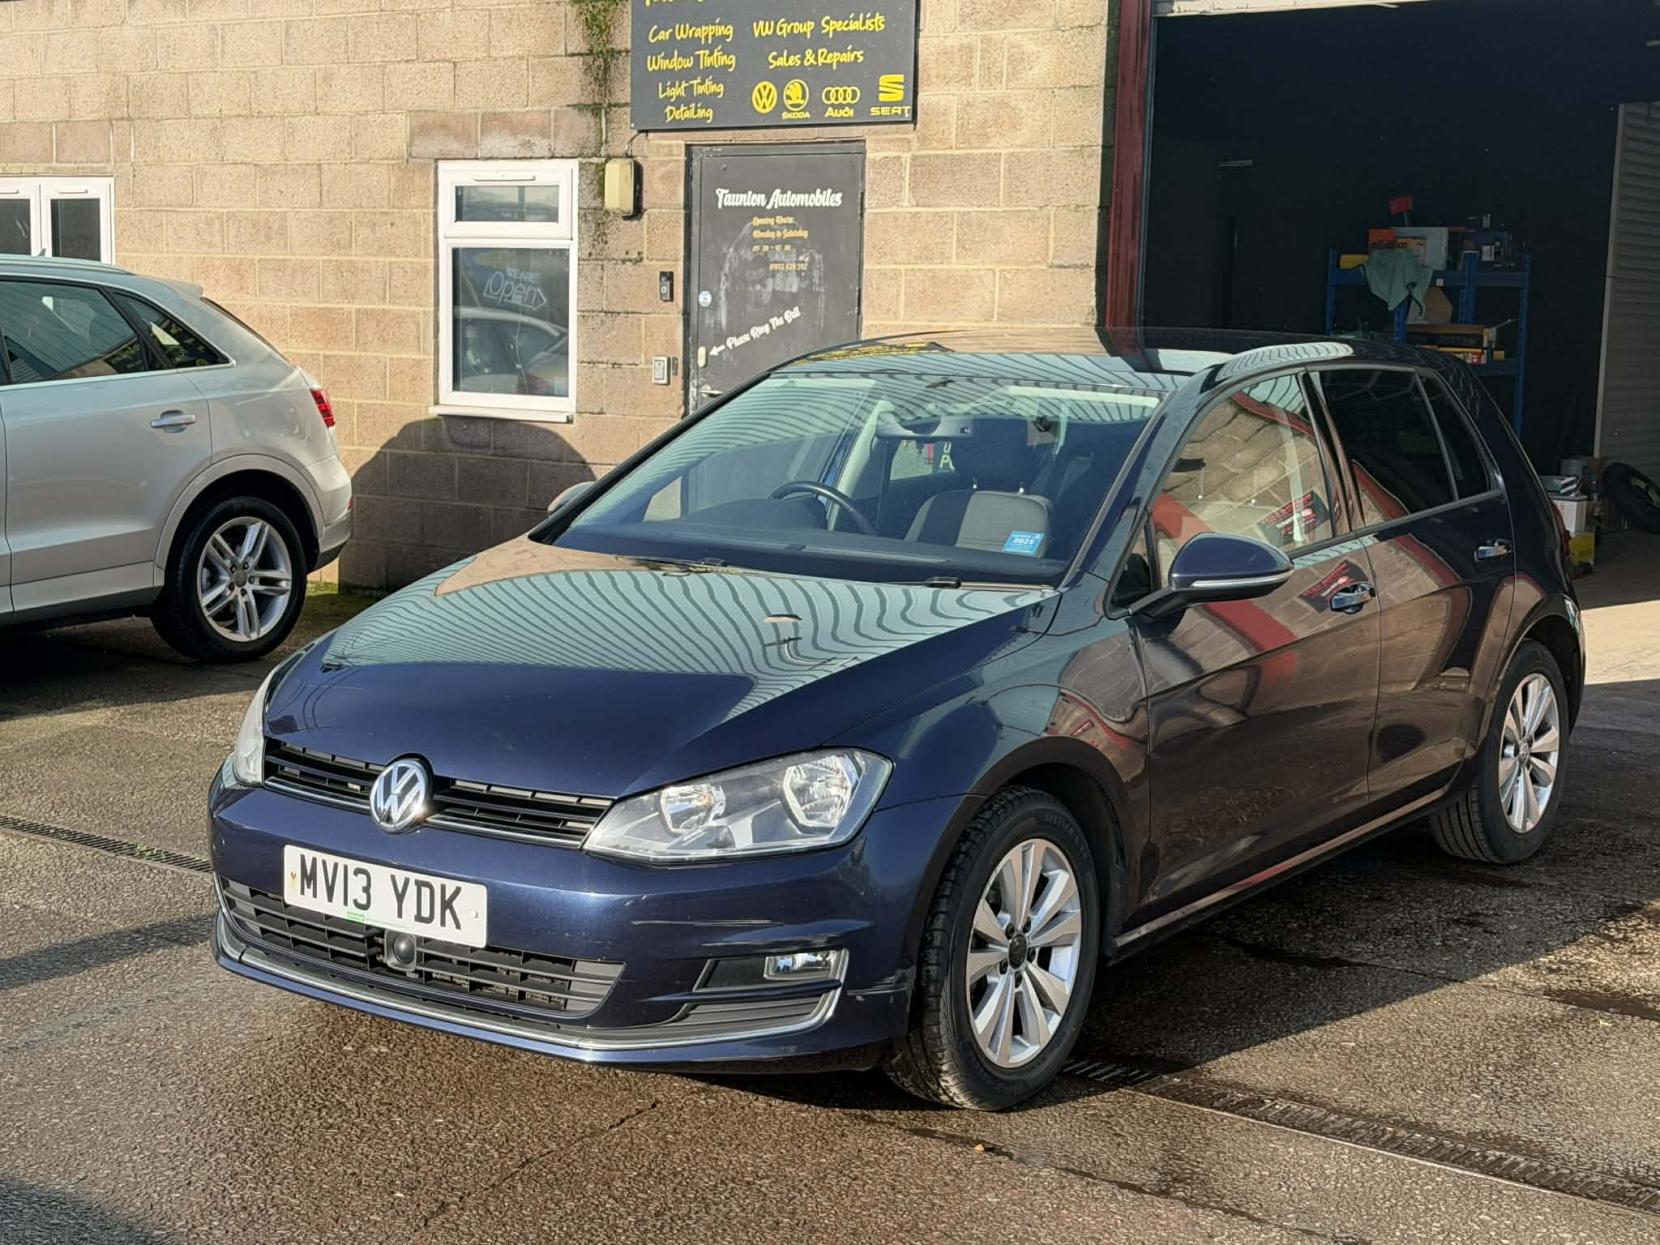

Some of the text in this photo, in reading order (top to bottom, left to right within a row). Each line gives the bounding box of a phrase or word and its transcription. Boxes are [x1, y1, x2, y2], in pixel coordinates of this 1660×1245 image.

[648, 17, 734, 44] Car Wrapping
[752, 12, 886, 39] VW Group Specialists
[646, 44, 736, 72] Window Tinting
[768, 44, 864, 70] Sales & Repairs
[658, 75, 724, 102] Light Tinting
[664, 102, 713, 123] Detailing
[825, 106, 854, 118] Audi
[870, 105, 912, 117] SEAT
[715, 187, 843, 210] Taunton Automobiles
[300, 853, 462, 930] MV13 YDK
